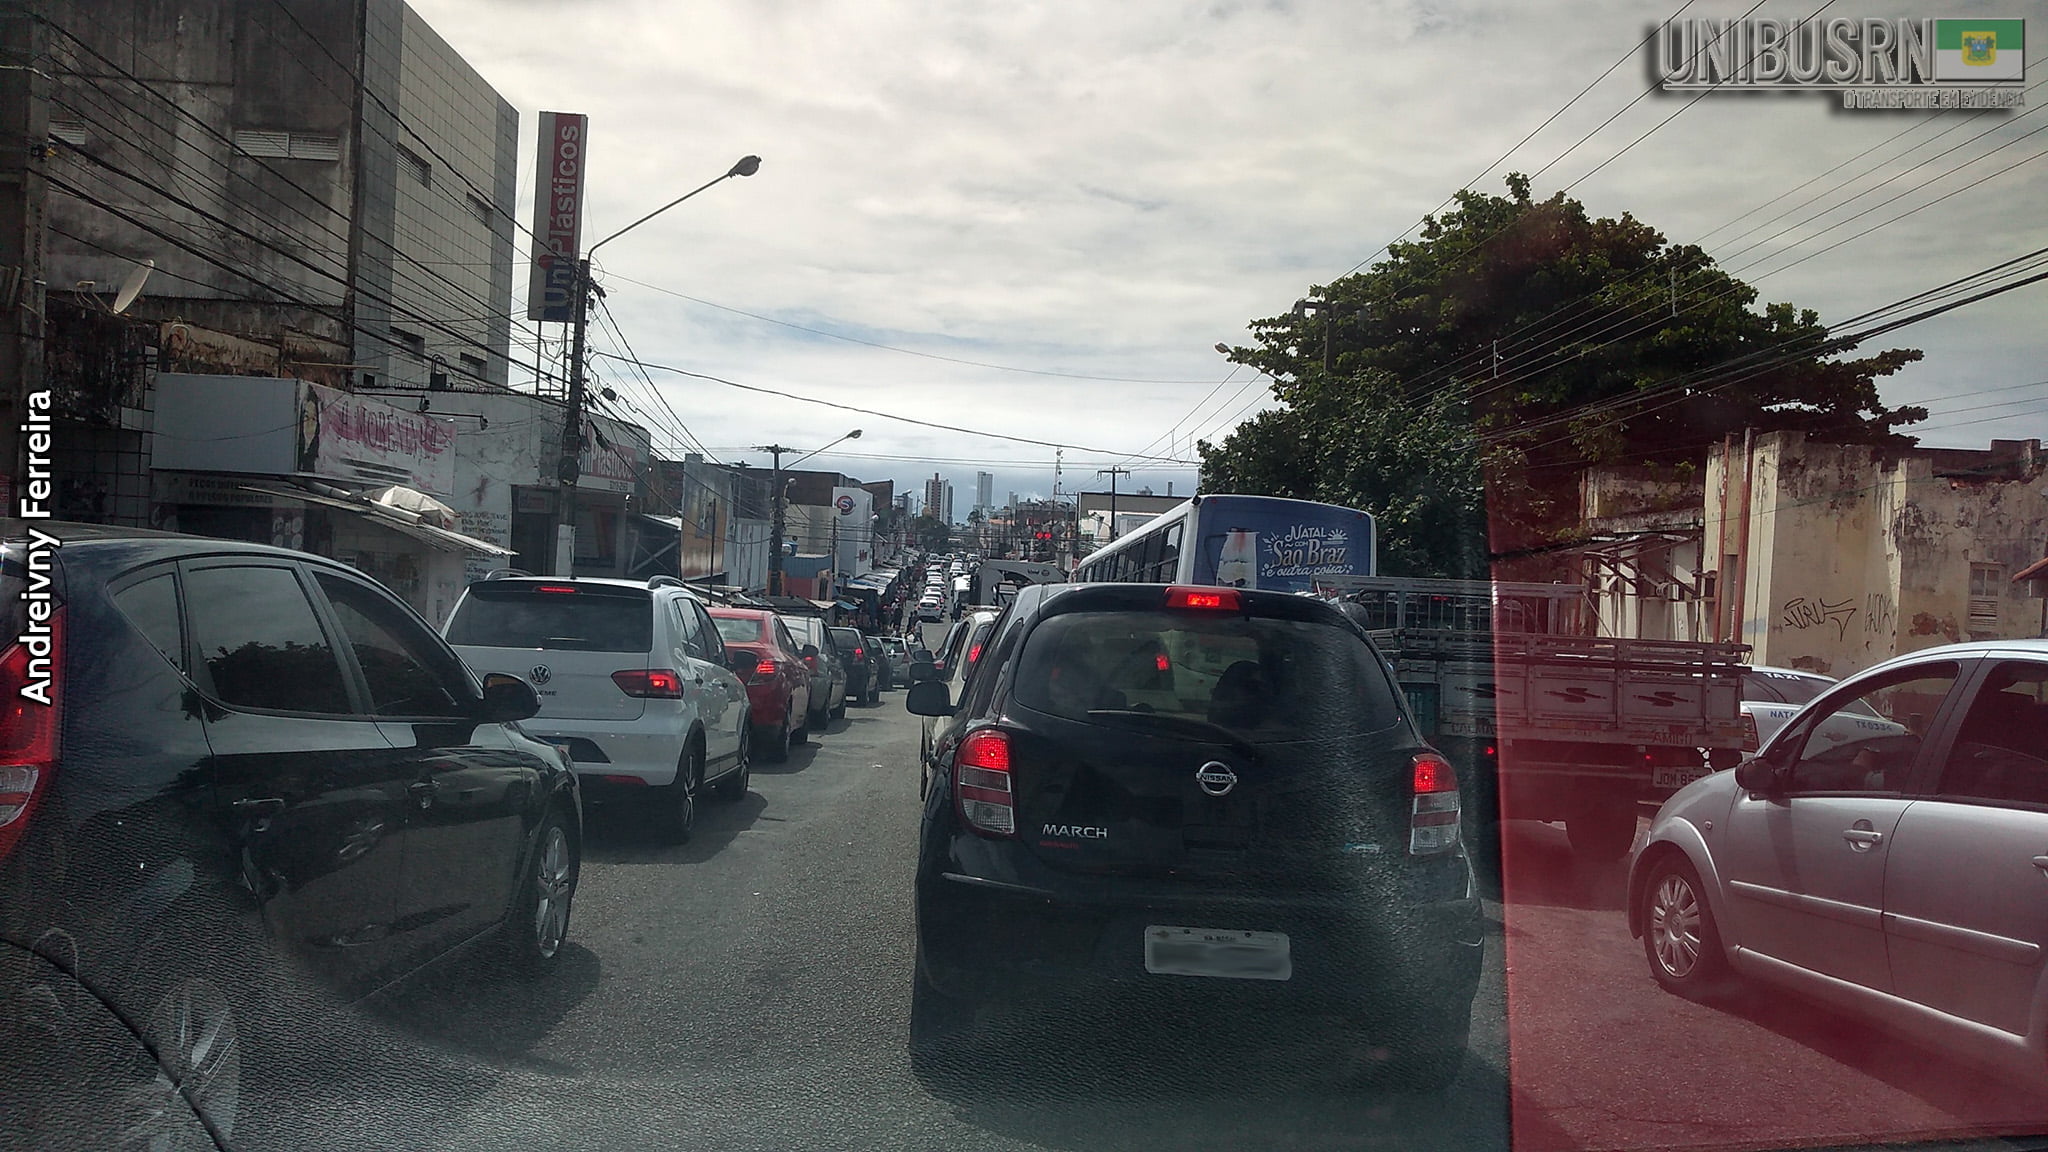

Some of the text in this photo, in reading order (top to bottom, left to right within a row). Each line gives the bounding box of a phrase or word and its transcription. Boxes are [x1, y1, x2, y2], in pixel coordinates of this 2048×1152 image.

[1284, 524, 1328, 542] NATAL
[1272, 538, 1346, 567] São Braz
[1277, 564, 1313, 576] outra
[1313, 563, 1346, 575] coisa
[1763, 672, 1801, 681] TAXI
[1199, 774, 1235, 783] NISSAN
[1042, 823, 1108, 839] MARCH
